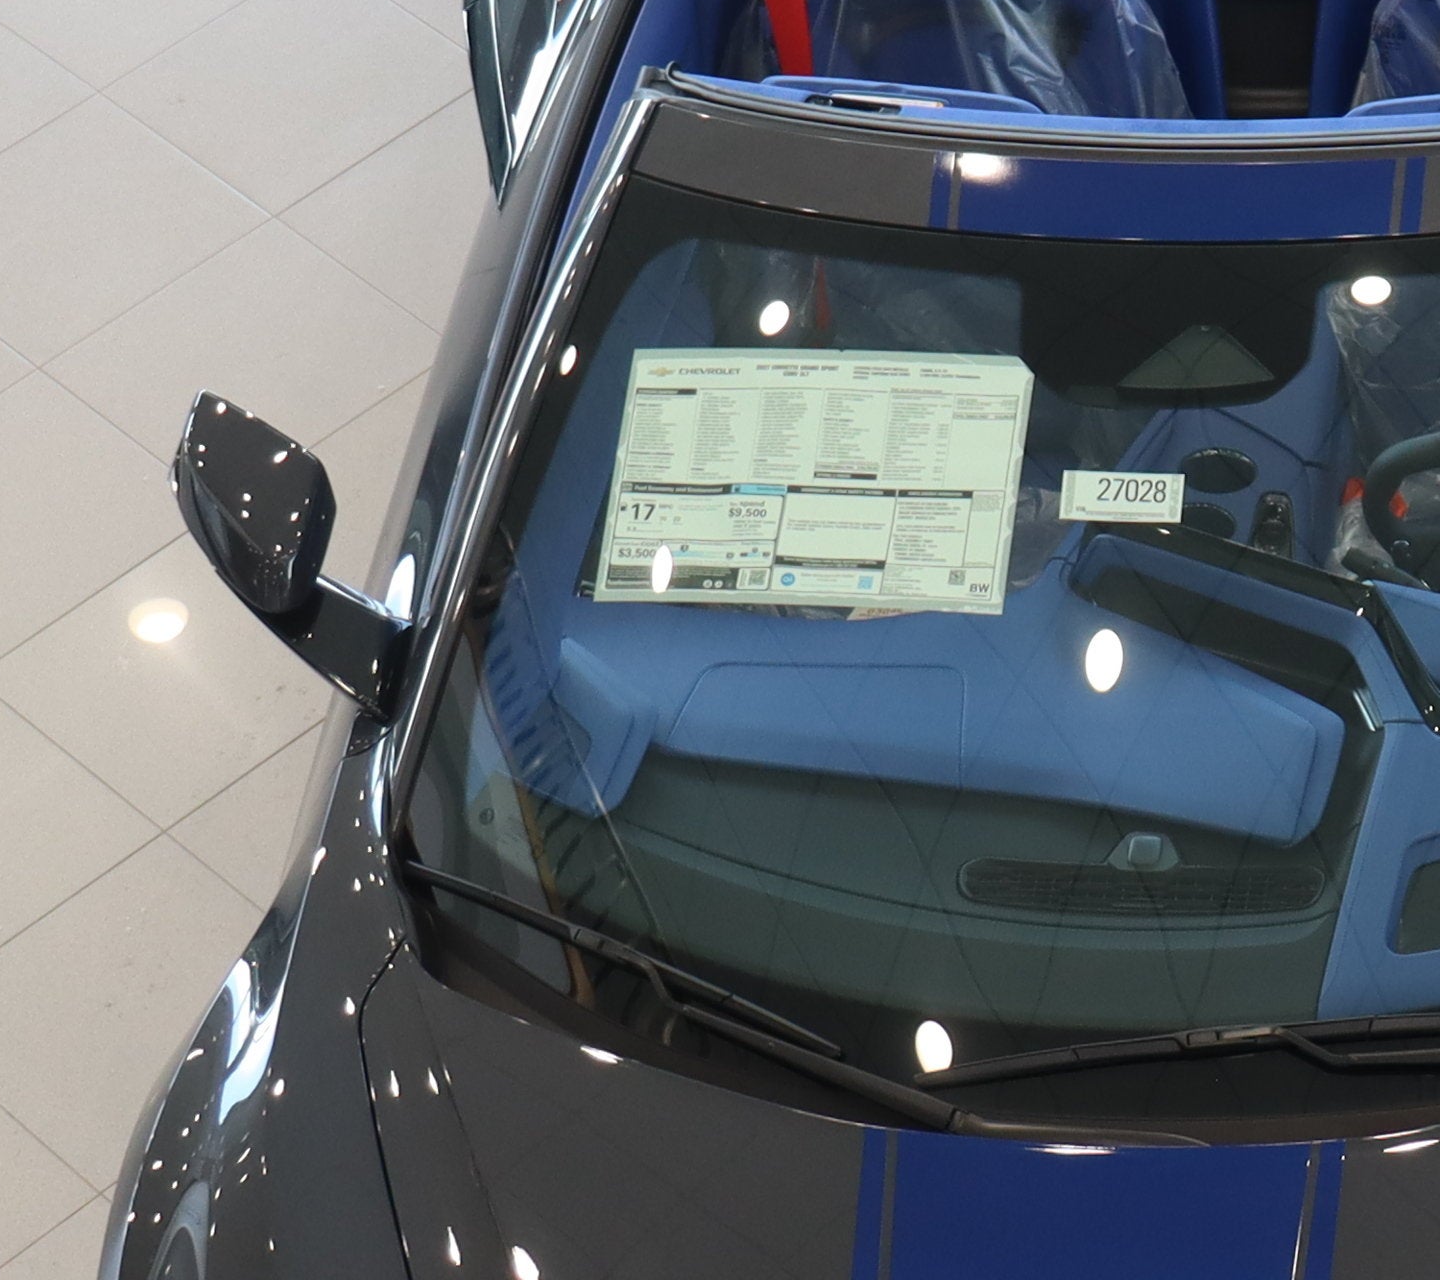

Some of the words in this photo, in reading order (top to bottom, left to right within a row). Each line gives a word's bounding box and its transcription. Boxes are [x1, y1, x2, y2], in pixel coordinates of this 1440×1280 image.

[678, 367, 741, 376] CHEVROLET
[1096, 478, 1167, 503] 27028
[631, 503, 657, 521] 17
[728, 507, 767, 518] $9,500
[618, 548, 656, 559] $3,500
[969, 583, 990, 593] BW
